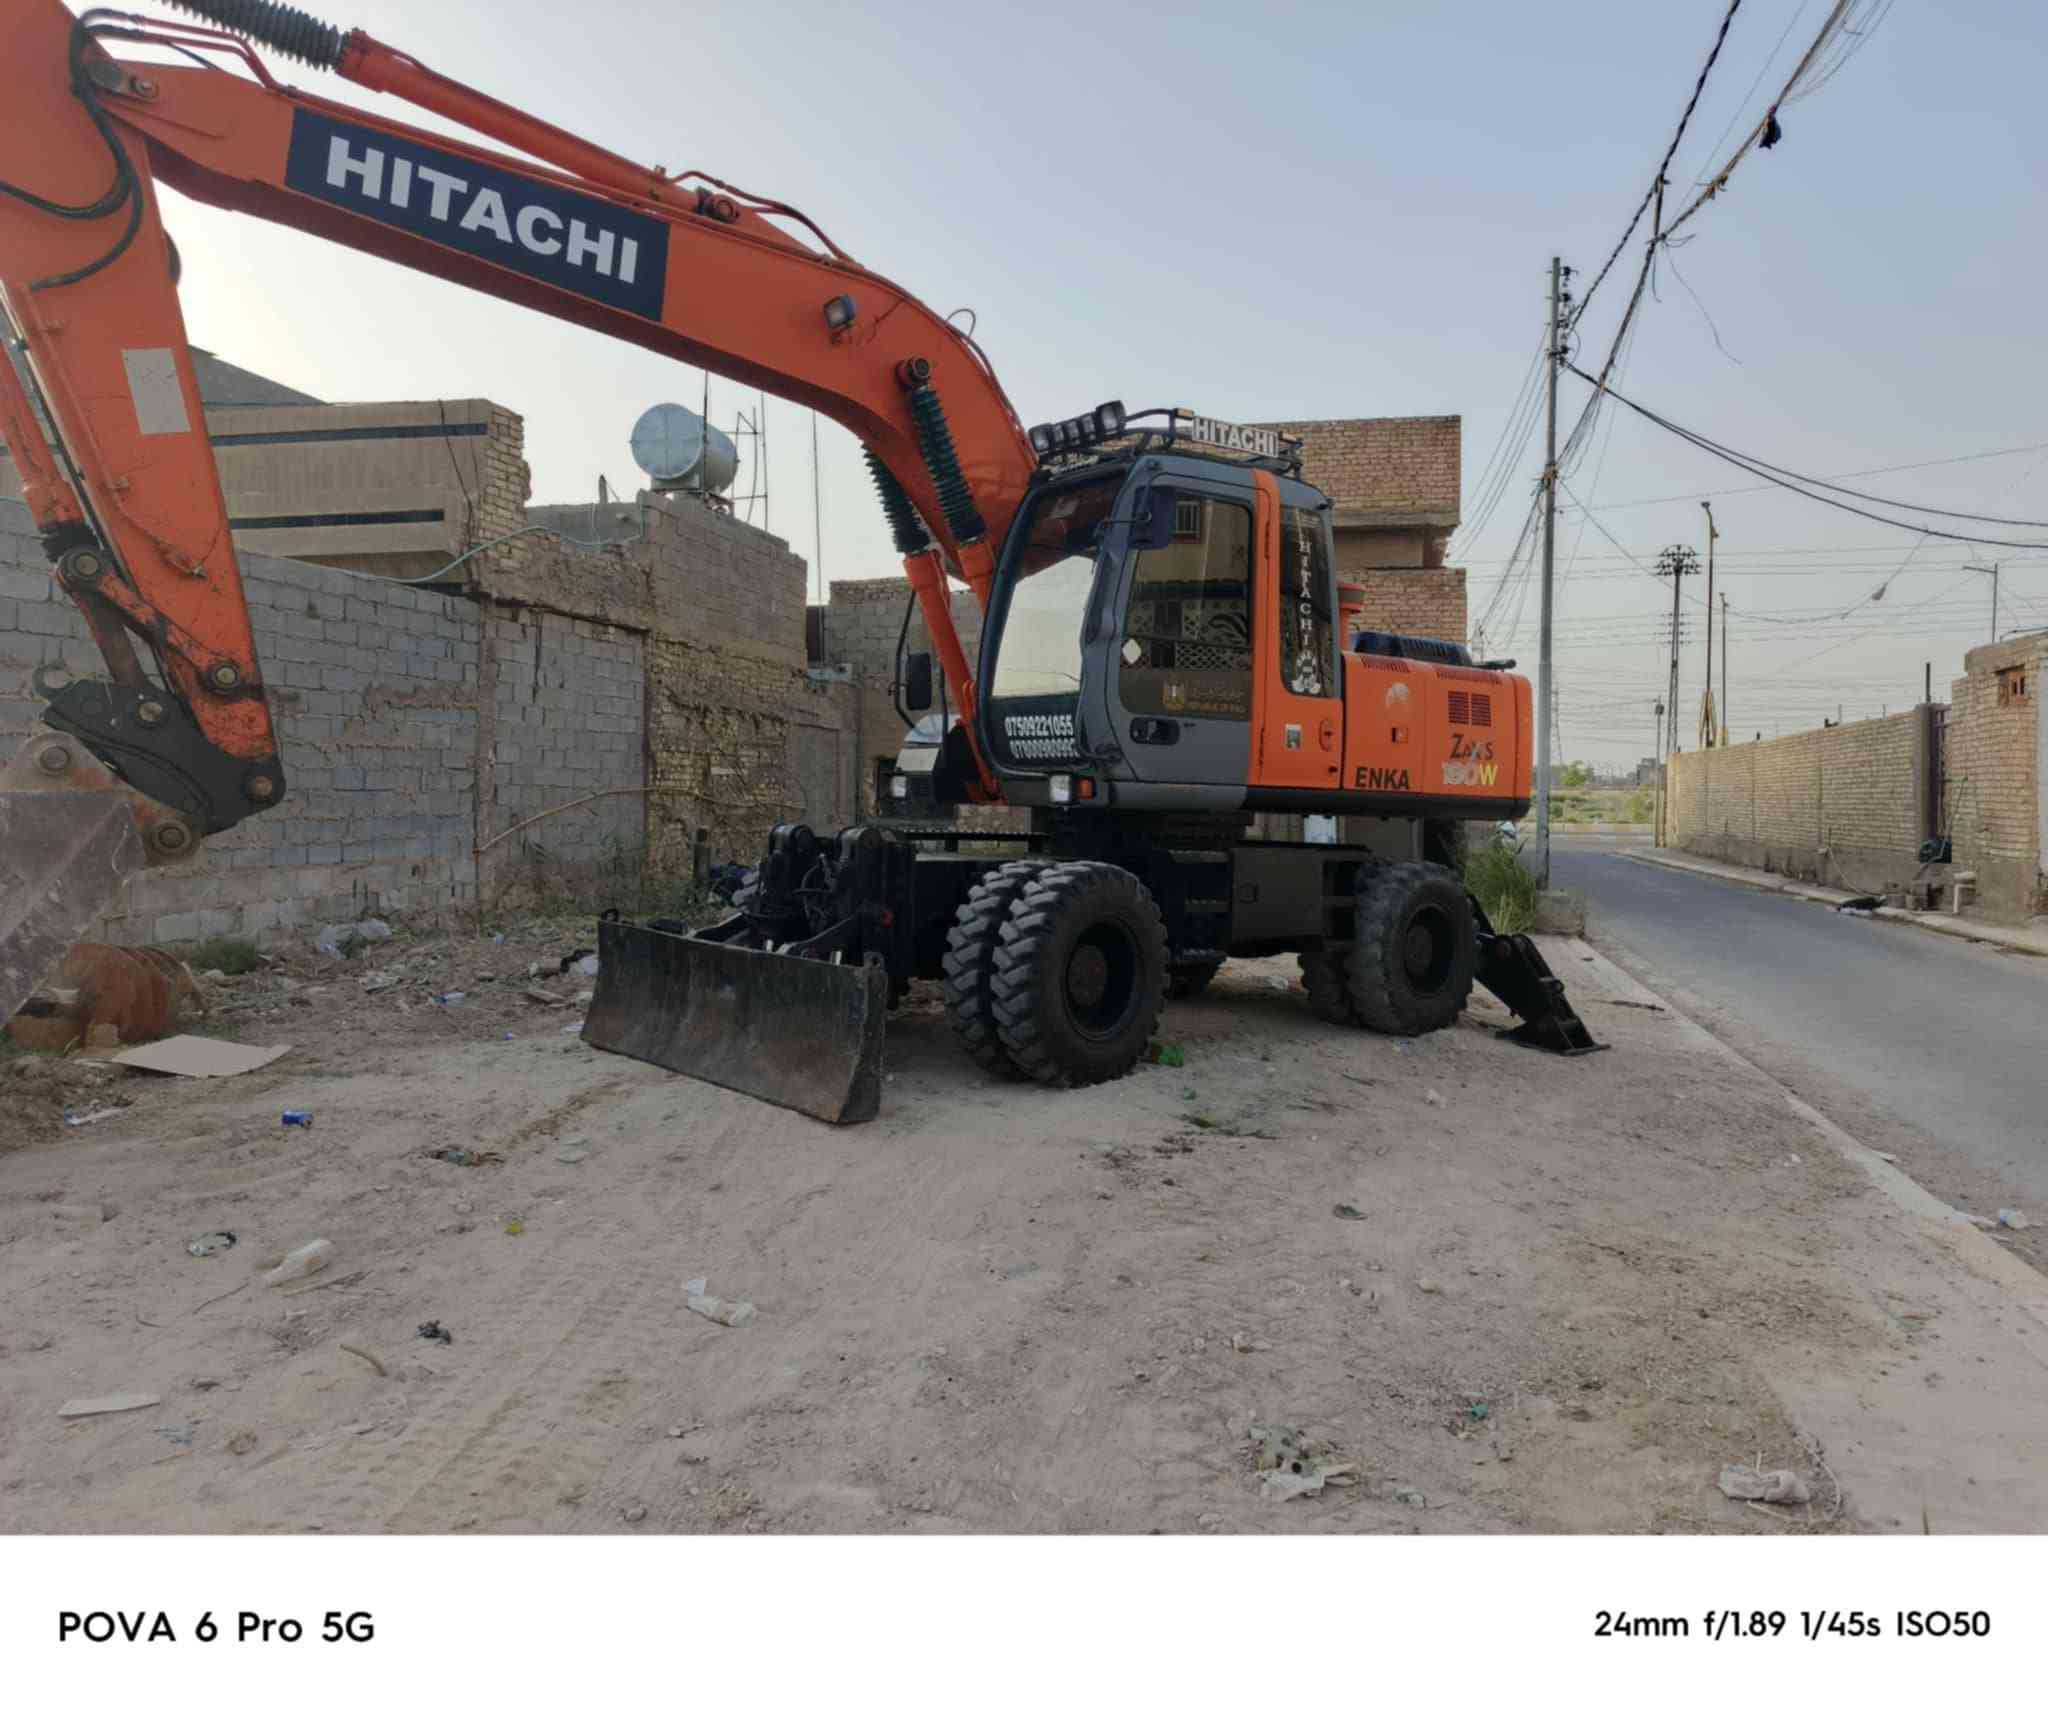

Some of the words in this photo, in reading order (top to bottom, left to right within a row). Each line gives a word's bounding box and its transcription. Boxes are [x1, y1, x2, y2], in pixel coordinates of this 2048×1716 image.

[326, 135, 639, 284] HITACHI
[1194, 417, 1277, 456] HITACHI
[1299, 541, 1313, 646] HITACHI
[1355, 766, 1410, 790] ENKA
